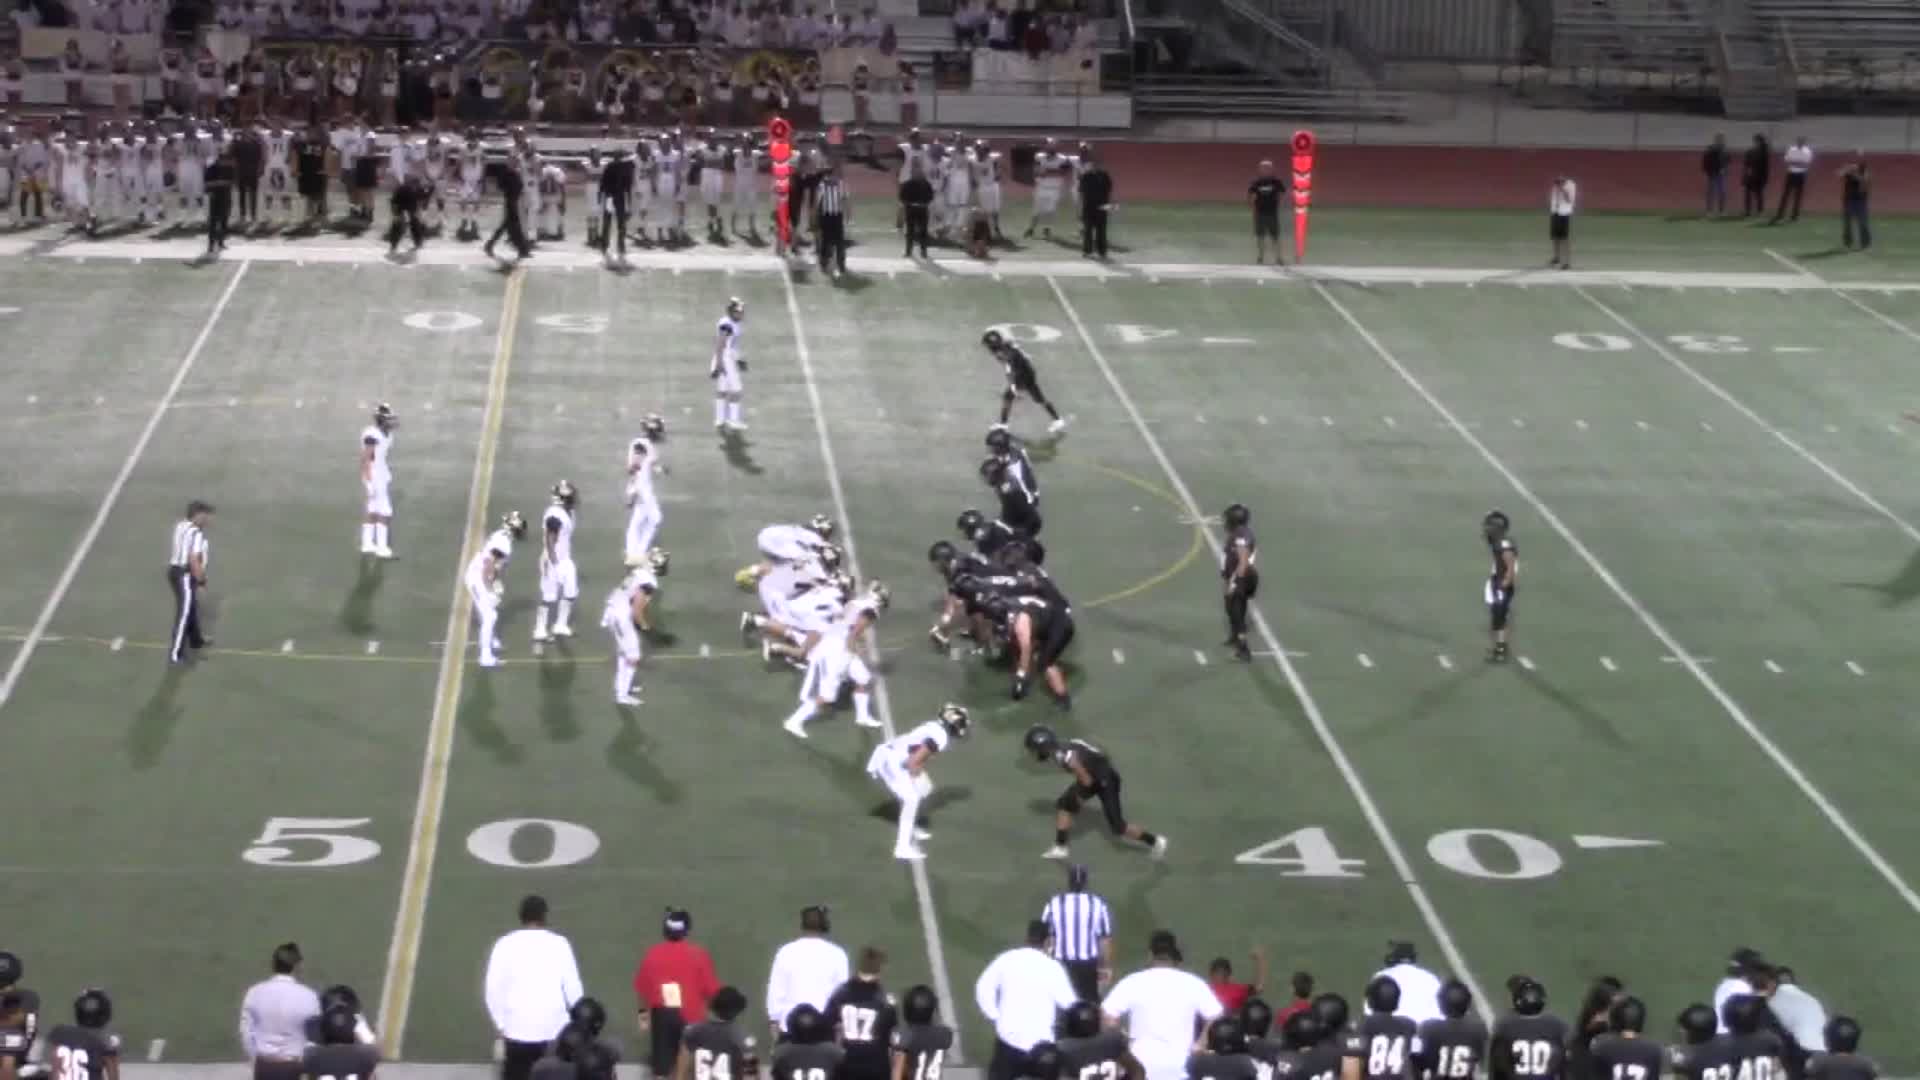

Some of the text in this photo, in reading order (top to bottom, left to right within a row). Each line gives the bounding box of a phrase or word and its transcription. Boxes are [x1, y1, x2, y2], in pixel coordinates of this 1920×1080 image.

[56, 1045, 90, 1080] 36
[694, 1047, 731, 1080] 64
[1368, 1034, 1405, 1075] 84
[1437, 1045, 1472, 1077] 16
[1512, 1039, 1551, 1075] 30
